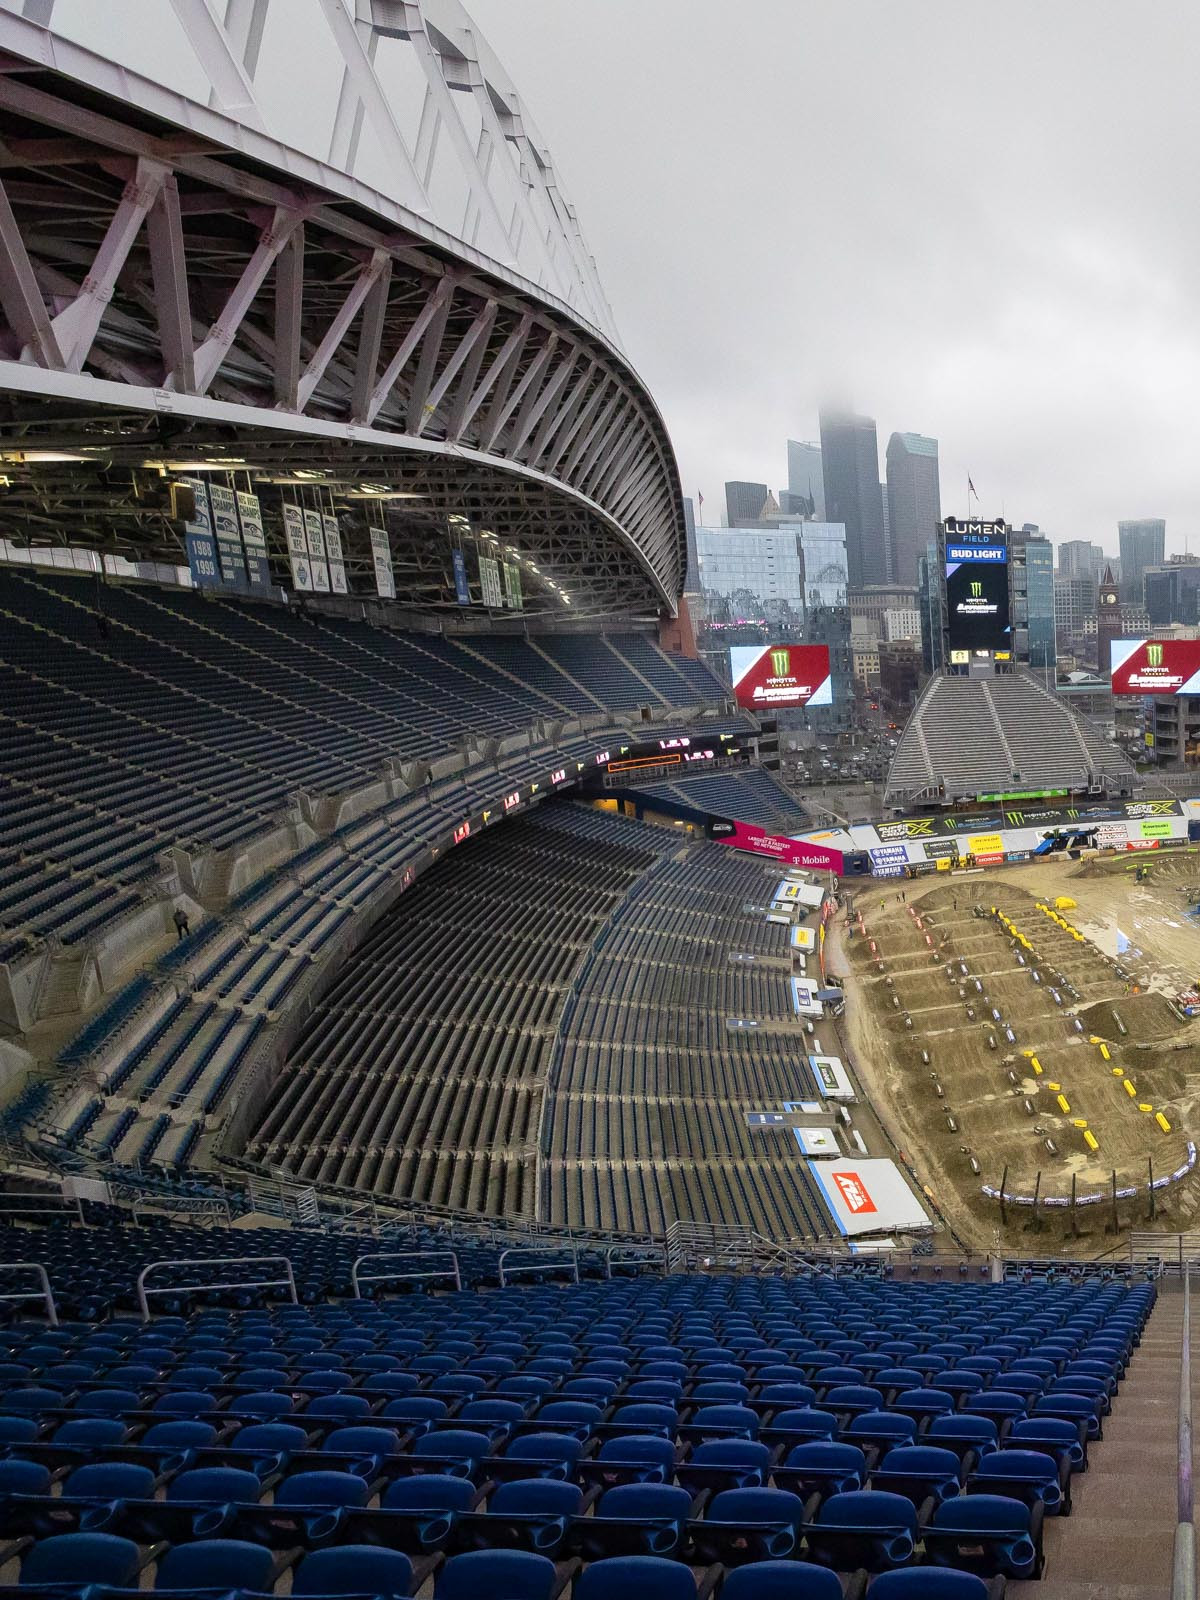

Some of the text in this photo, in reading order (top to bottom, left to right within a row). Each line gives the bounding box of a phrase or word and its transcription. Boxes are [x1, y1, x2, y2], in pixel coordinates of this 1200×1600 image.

[945, 523, 1005, 534] LUMEN
[951, 550, 1002, 559] BUD LIGHT
[195, 560, 215, 575] 1999
[802, 856, 830, 864] Mobile
[883, 855, 906, 863] YAMAHA
[878, 866, 901, 874] YAMAHA
